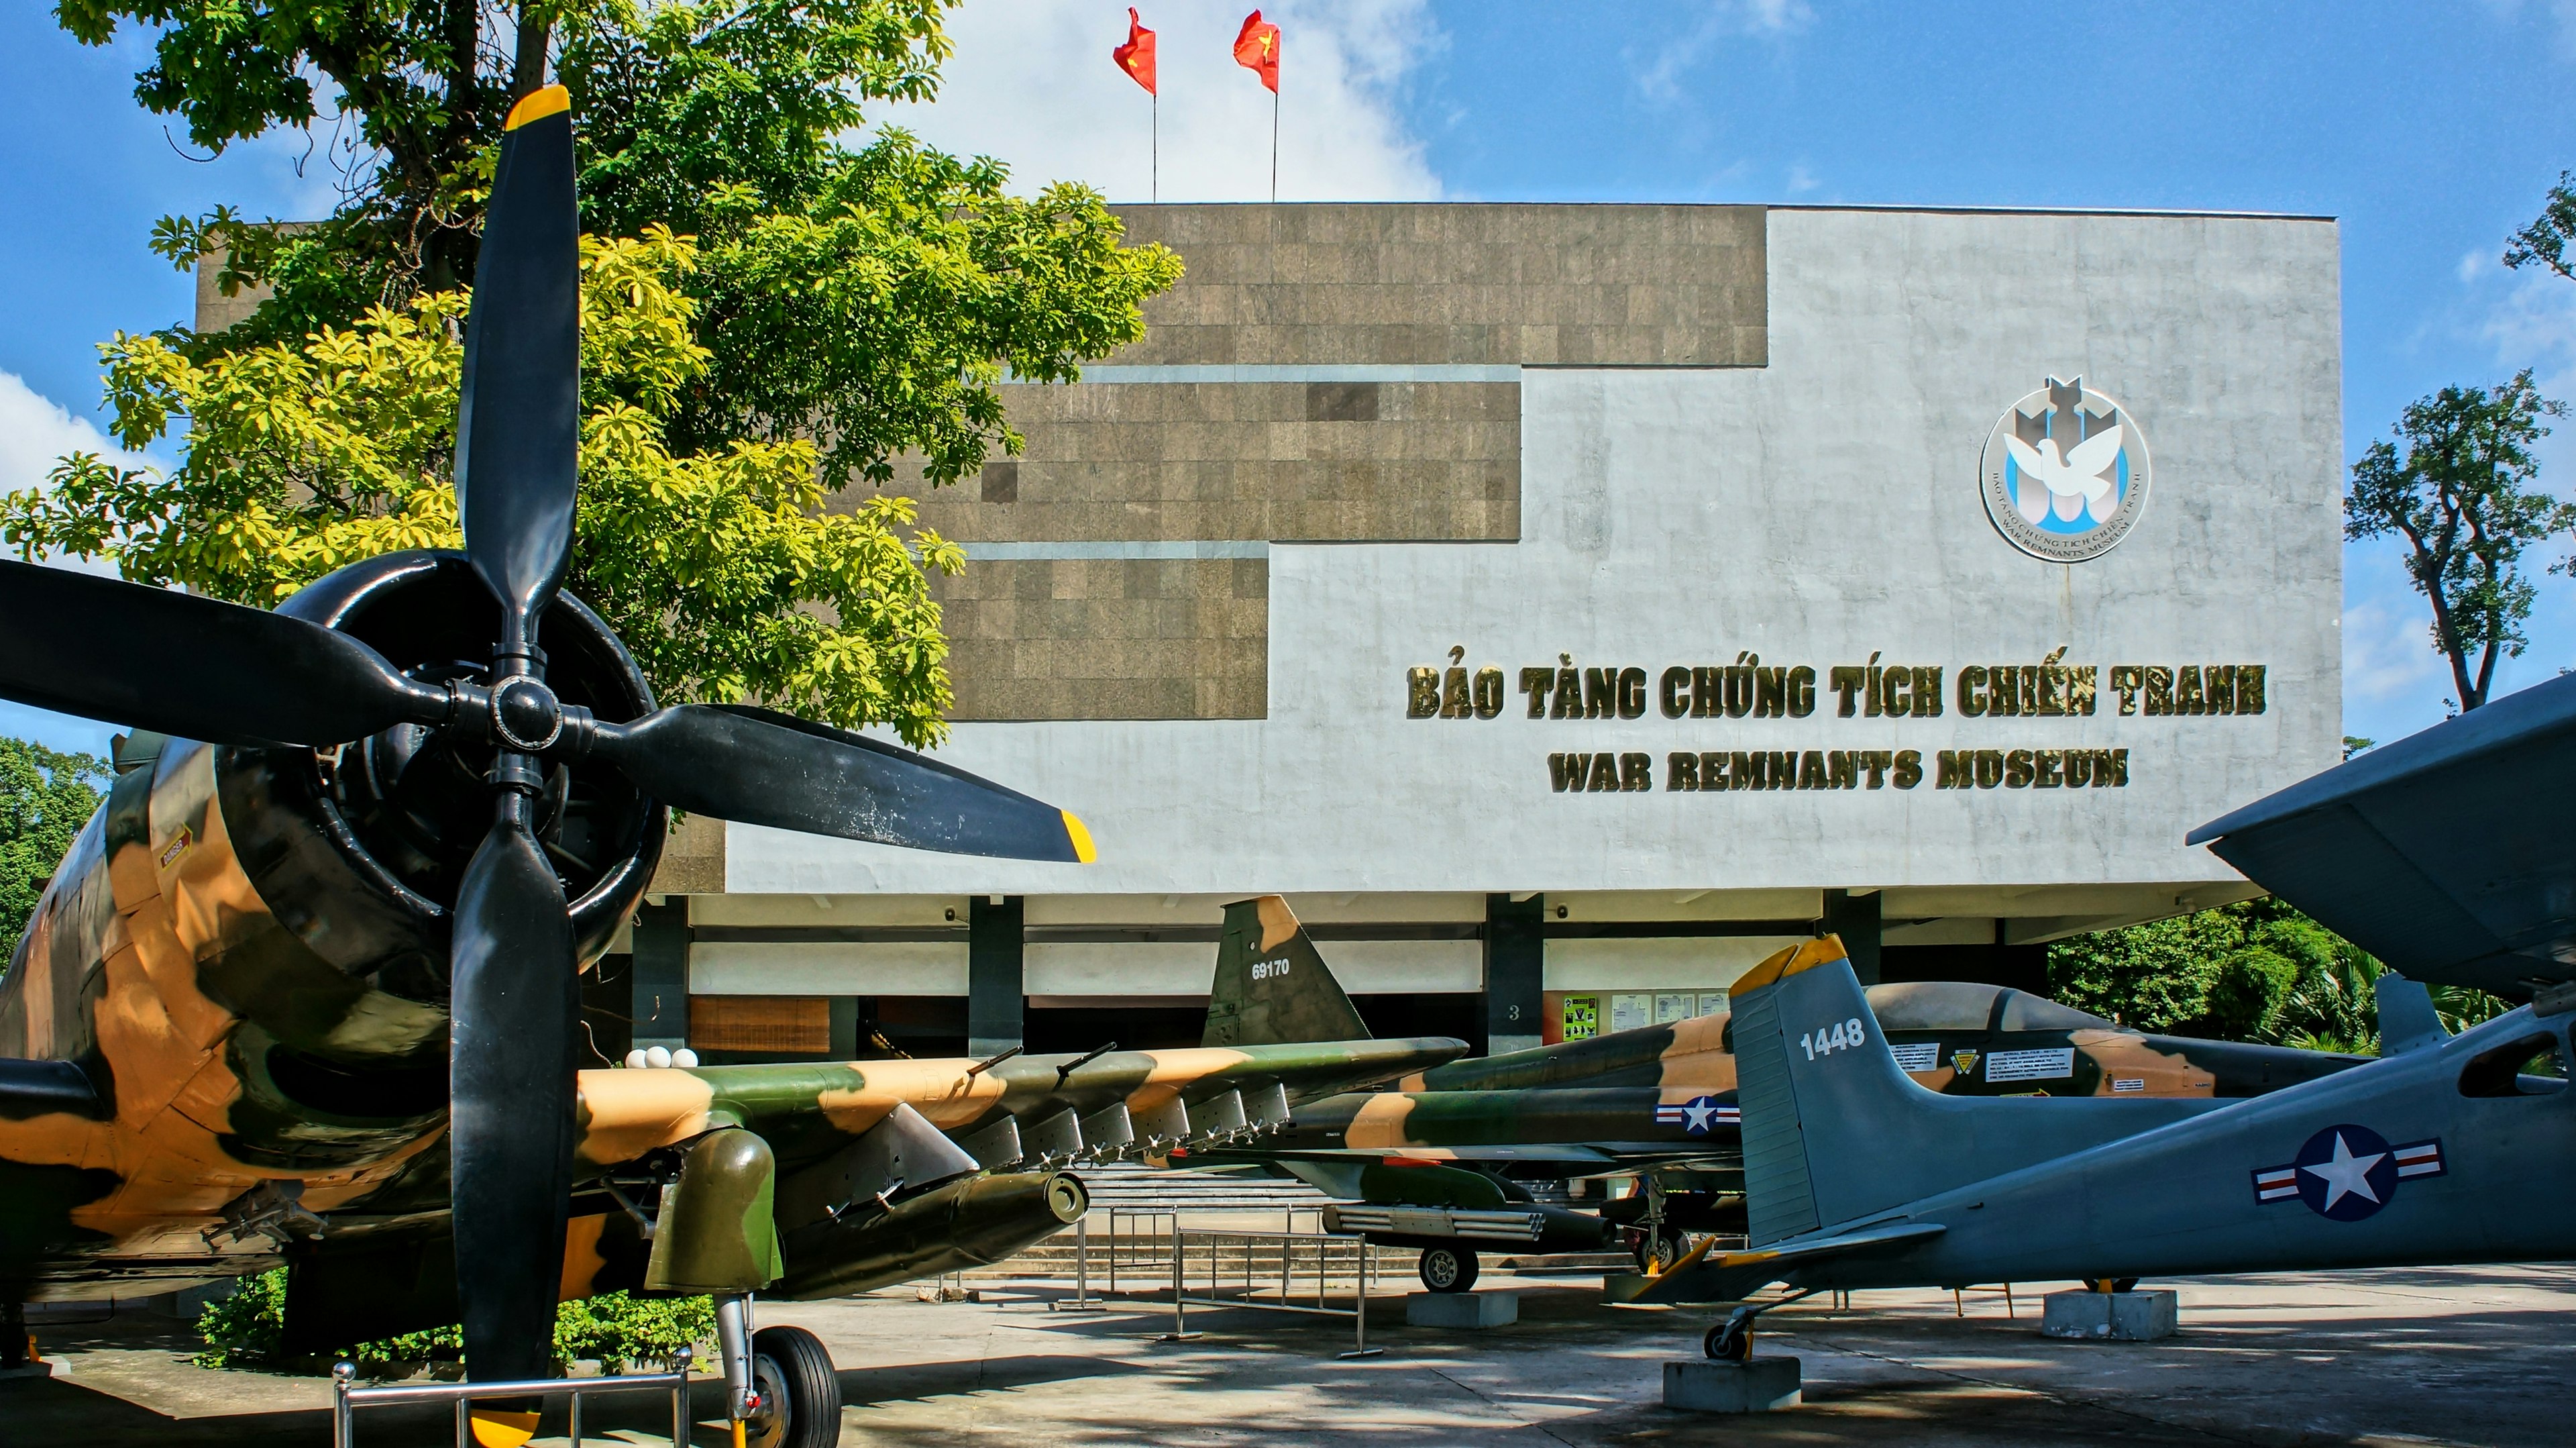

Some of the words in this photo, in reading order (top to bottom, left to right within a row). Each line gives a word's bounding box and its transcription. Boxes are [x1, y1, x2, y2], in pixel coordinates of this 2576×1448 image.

[2123, 474, 2141, 514] TRANH
[2002, 519, 2021, 539] WAR
[2023, 539, 2084, 556] REMNANTS
[2088, 522, 2130, 553] MUSEUM
[1406, 645, 1504, 720] BẢO
[1519, 652, 1646, 720] TÀNG
[1660, 651, 1815, 719] CHỨNG
[1830, 651, 1943, 719] TÍCH
[1958, 646, 2098, 718] CHIẾN
[2110, 665, 2267, 717] TRANH
[1547, 752, 1652, 793] WAR
[1666, 749, 1923, 792] REMNANTS
[1936, 748, 2129, 790] MUSEUM
[164, 839, 183, 865] DANGER
[1252, 958, 1289, 980] 69170
[1509, 1004, 1519, 1021] 3
[1801, 1018, 1865, 1061] 1448
